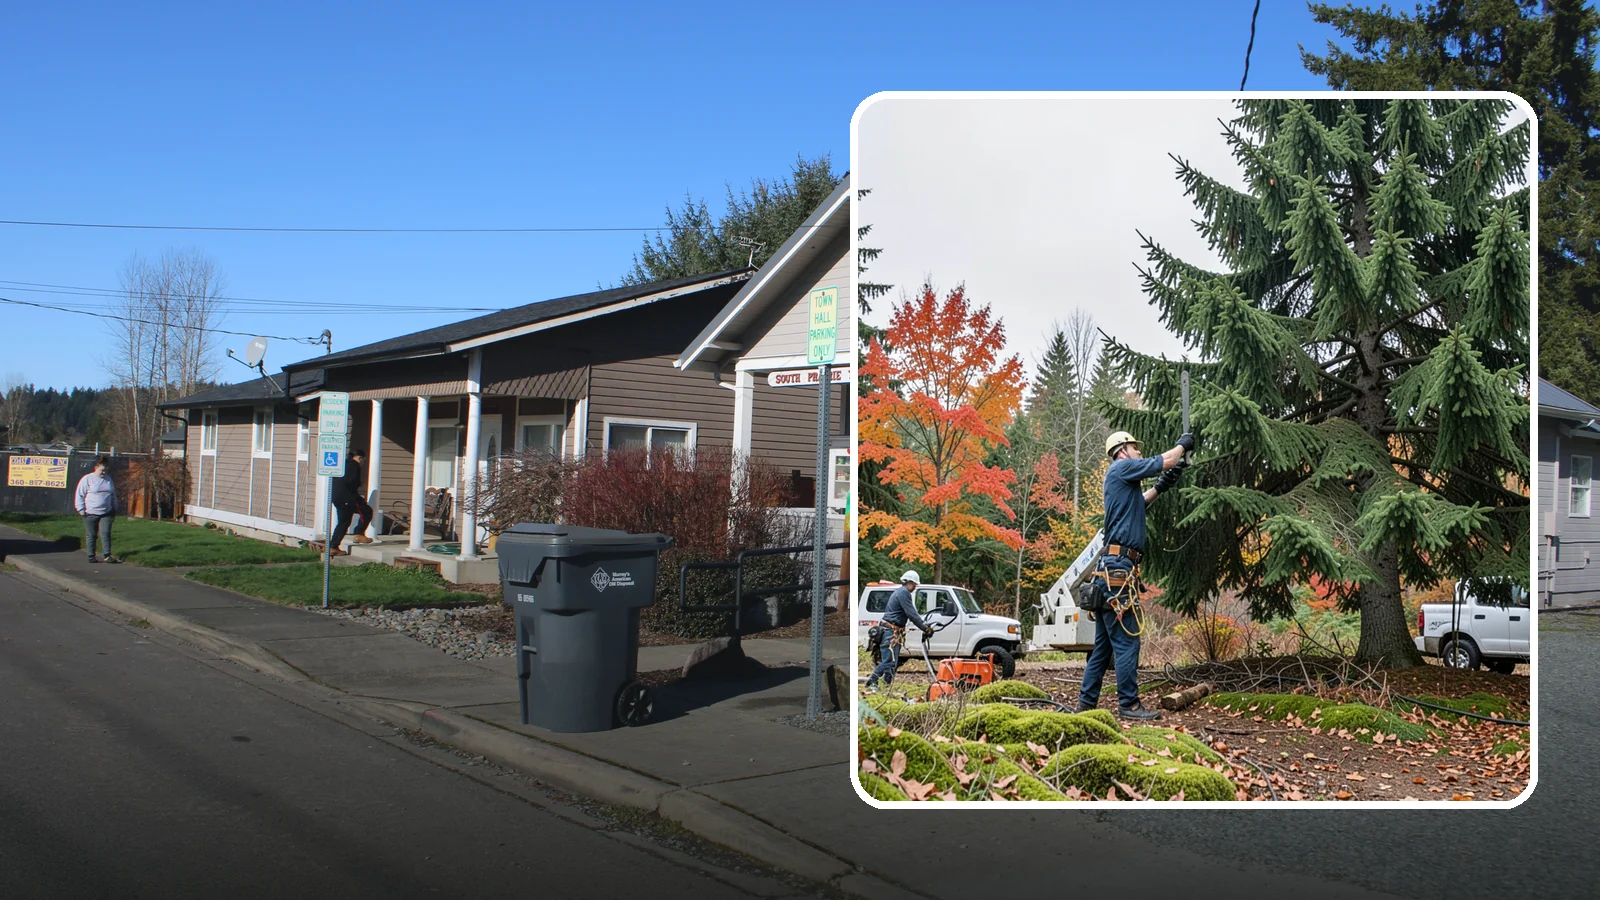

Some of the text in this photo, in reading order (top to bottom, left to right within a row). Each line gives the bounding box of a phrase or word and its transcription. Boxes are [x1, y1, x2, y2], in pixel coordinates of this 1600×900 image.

[815, 295, 832, 308] TOWN
[814, 312, 831, 324] HALL
[809, 327, 836, 341] PARKING
[813, 344, 831, 357] ONLY
[776, 374, 801, 384] SOUTH
[11, 457, 26, 465] COAST
[11, 479, 65, 487] 360-897-8625
